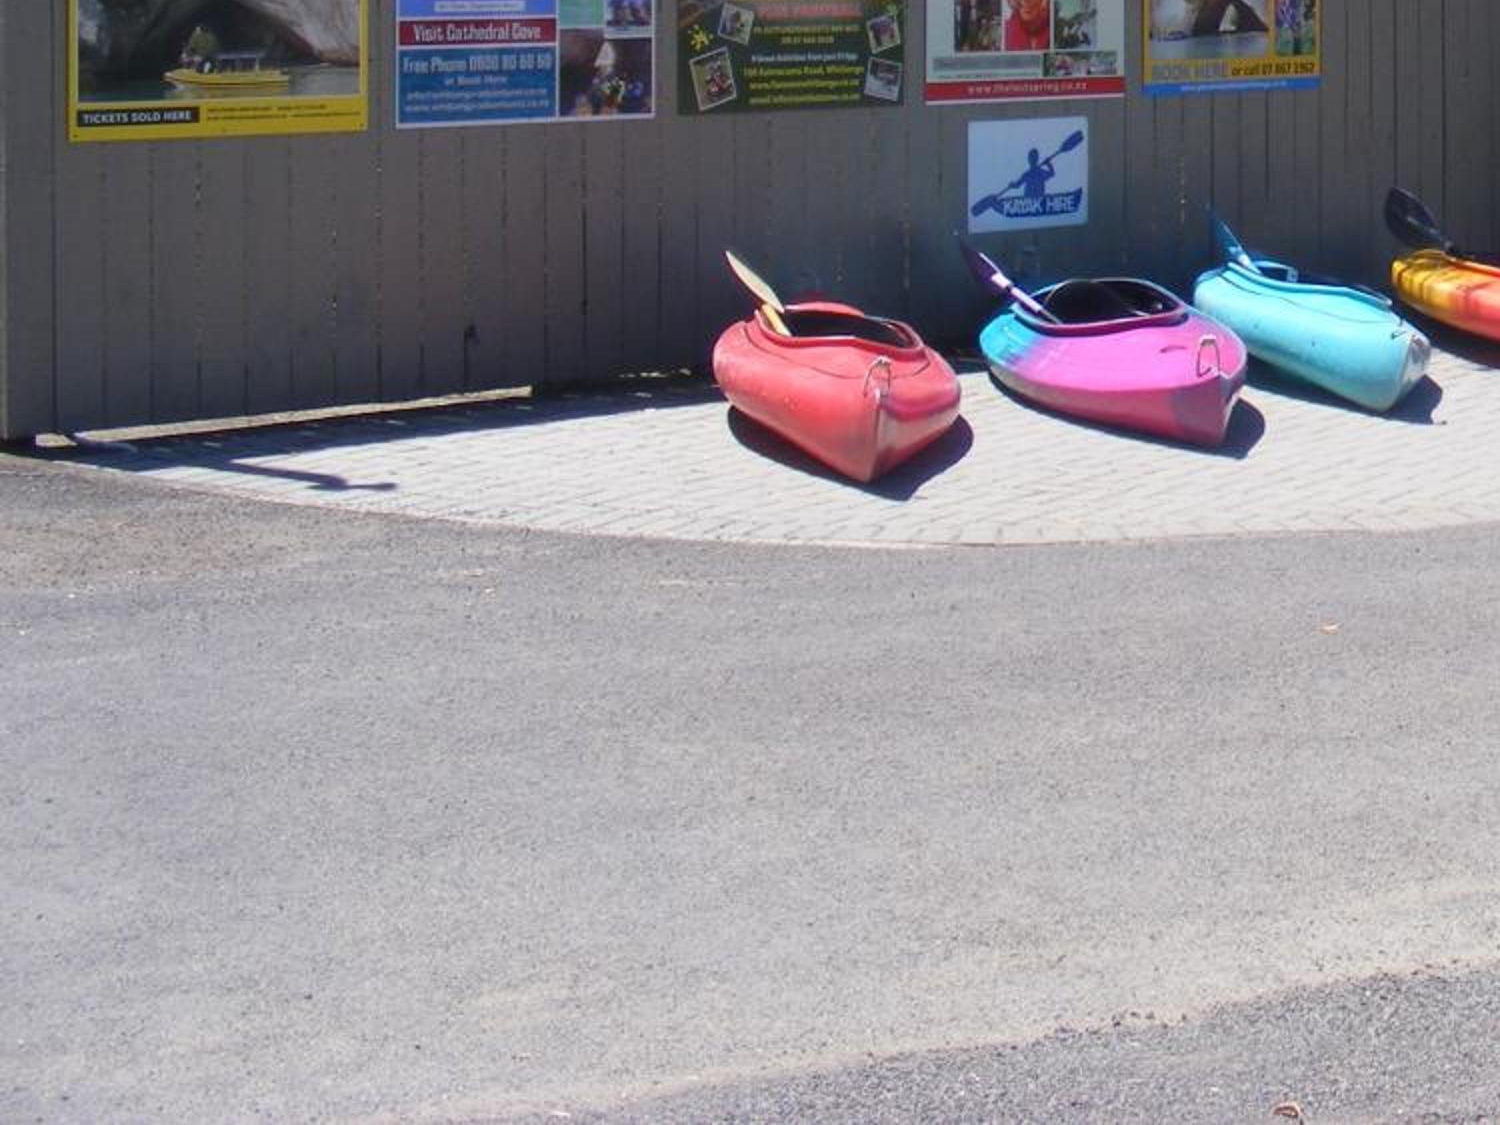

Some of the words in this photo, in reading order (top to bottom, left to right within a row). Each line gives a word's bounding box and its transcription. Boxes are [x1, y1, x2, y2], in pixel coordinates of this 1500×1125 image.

[413, 23, 444, 42] Visit
[446, 22, 510, 42] Cathedral
[512, 22, 541, 39] Cove
[83, 112, 129, 124] TICKETS
[131, 111, 161, 122] SOLD
[163, 109, 192, 121] HERE
[1003, 197, 1042, 215] KAYAK
[1046, 194, 1076, 212] HIRE
